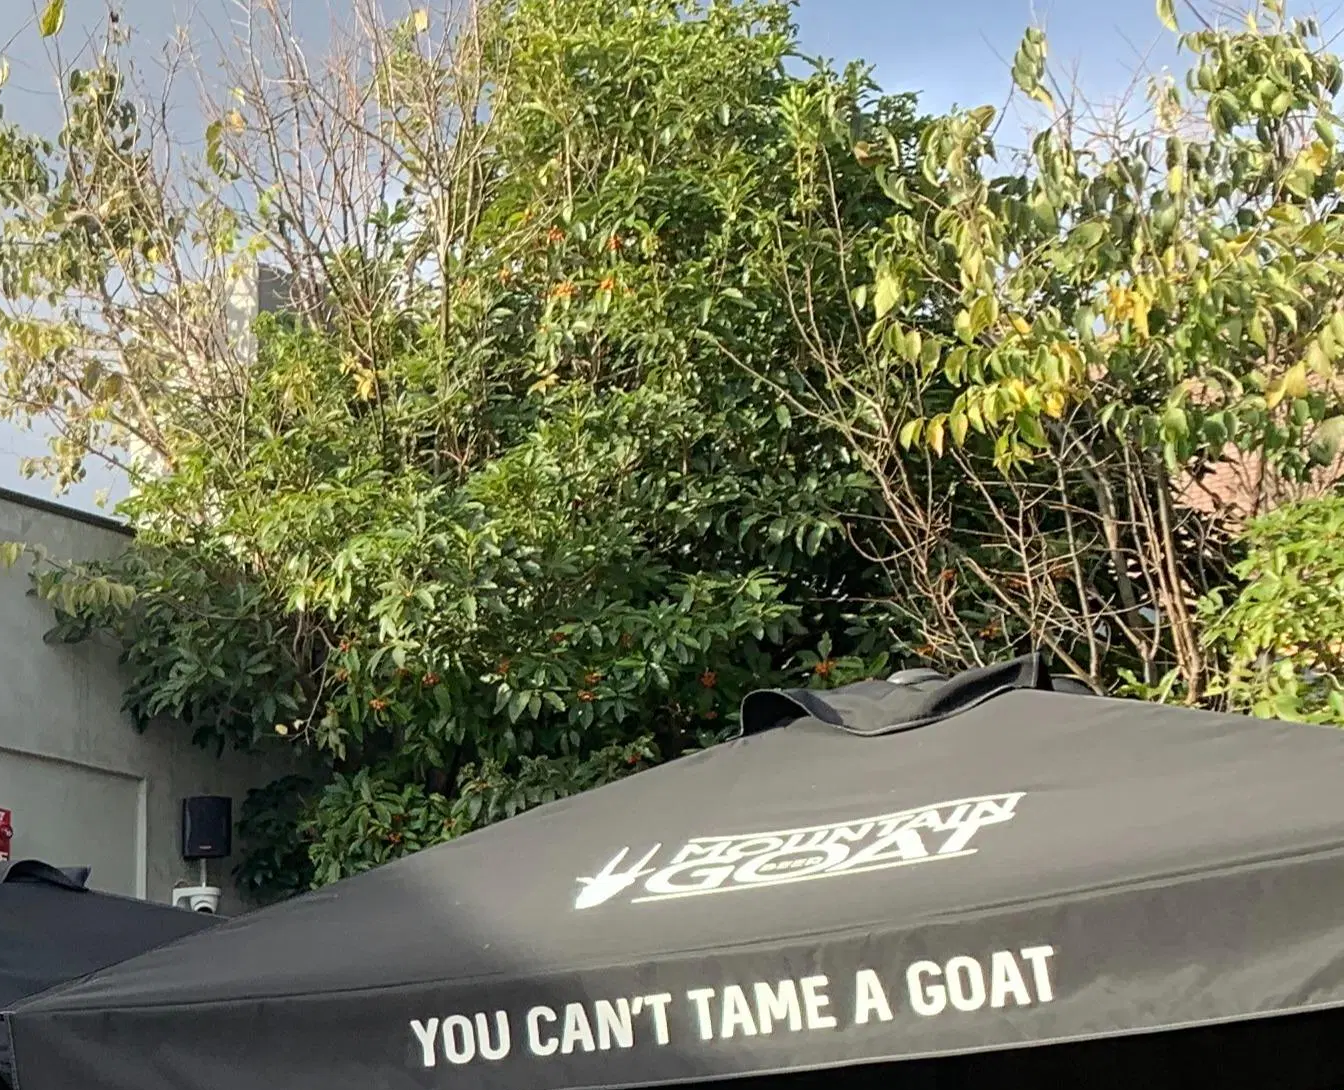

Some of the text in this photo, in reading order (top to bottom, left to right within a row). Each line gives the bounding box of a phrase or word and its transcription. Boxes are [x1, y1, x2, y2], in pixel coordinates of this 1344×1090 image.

[644, 812, 1016, 894] GOAT
[669, 792, 1025, 864] MOUNTAIN
[410, 945, 1055, 1067] YOU CAN'T TAME A GOAT
